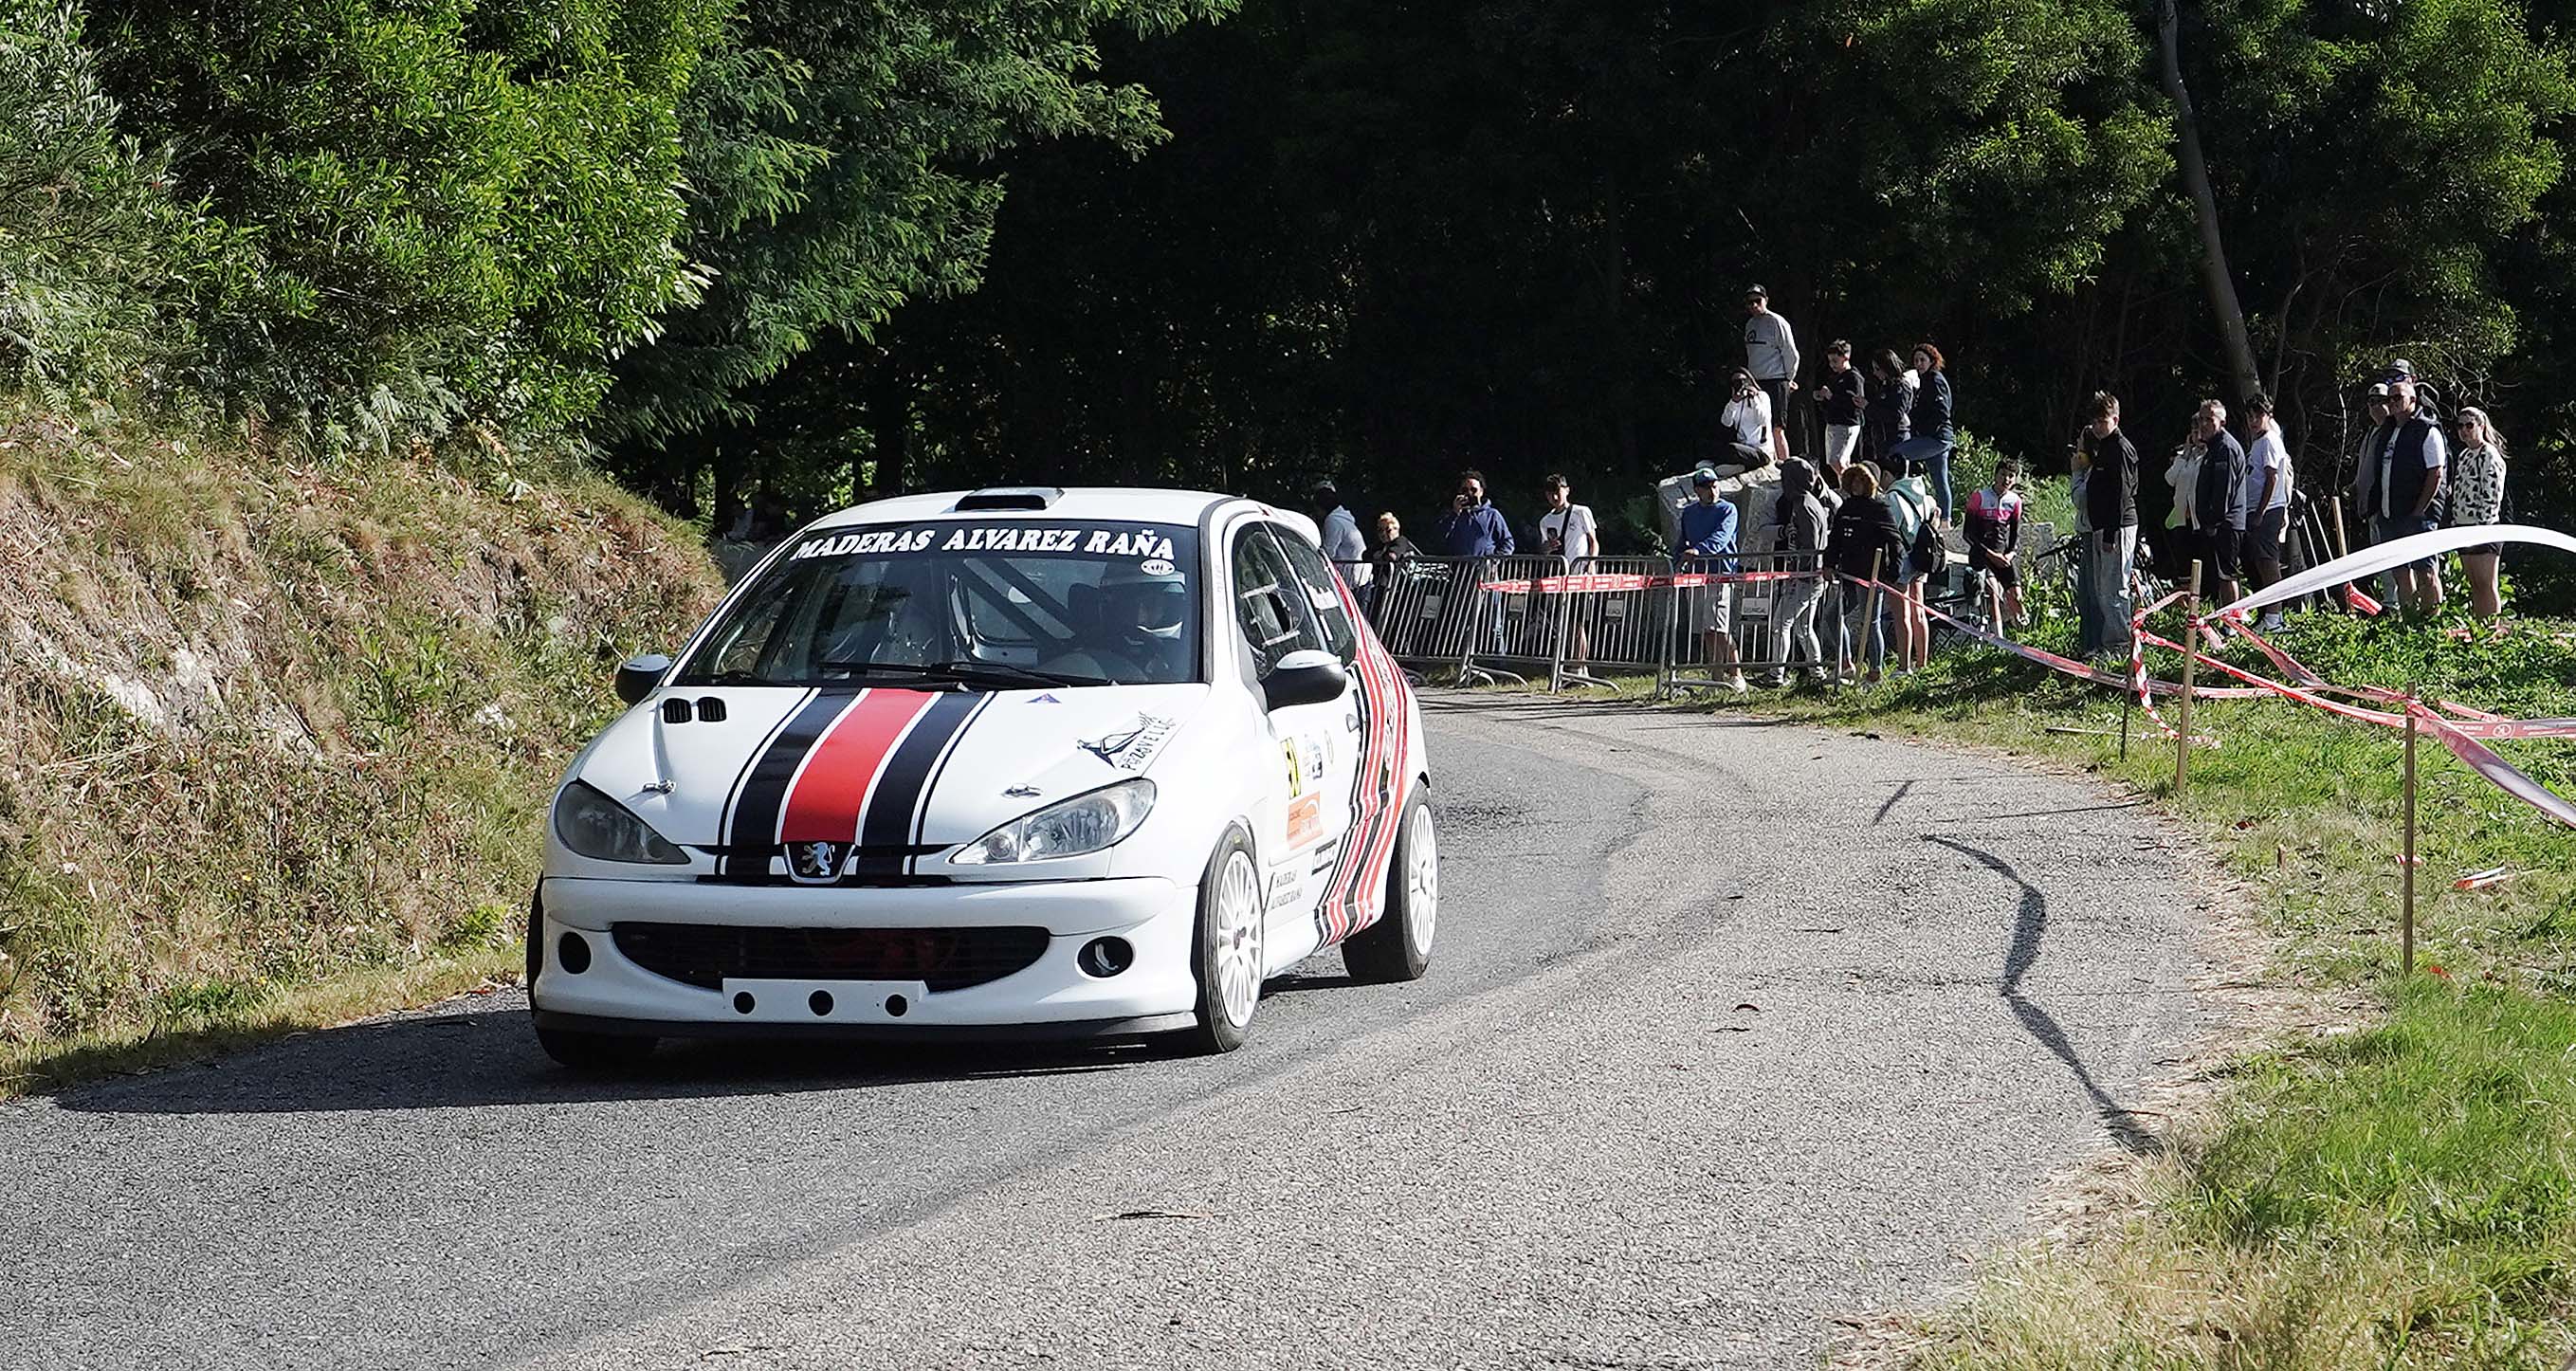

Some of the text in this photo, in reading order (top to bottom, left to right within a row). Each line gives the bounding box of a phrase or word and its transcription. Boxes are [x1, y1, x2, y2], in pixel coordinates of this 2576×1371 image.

[789, 528, 1175, 561] MADERAS ALVAREZ RAÑA
